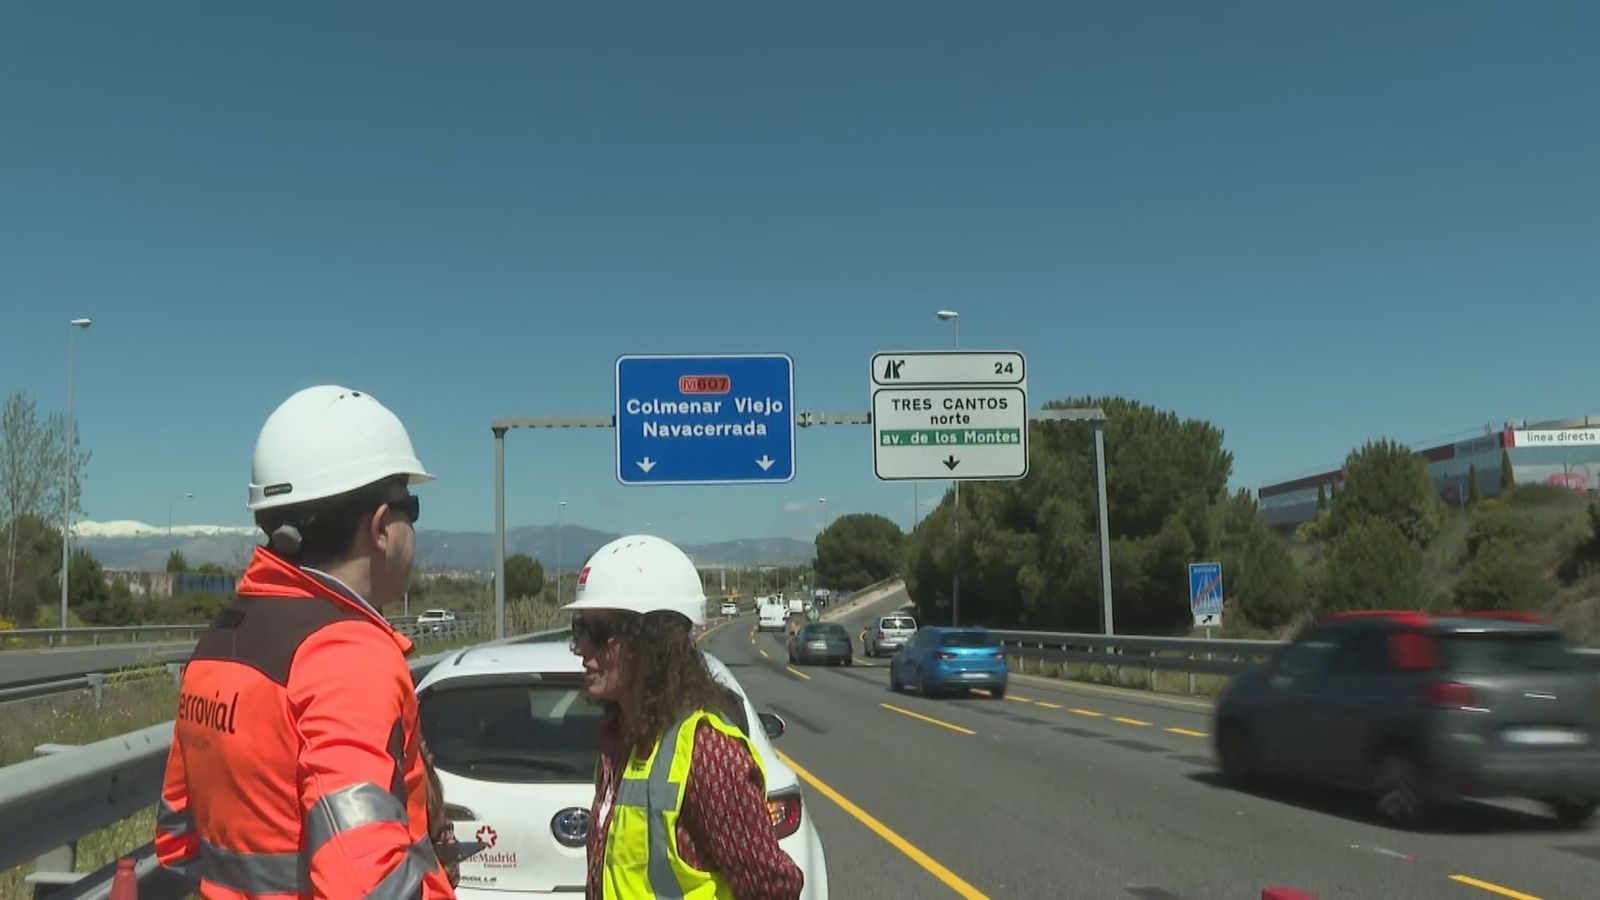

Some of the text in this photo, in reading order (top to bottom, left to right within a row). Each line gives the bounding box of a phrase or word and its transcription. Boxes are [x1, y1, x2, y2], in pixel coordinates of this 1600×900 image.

[994, 361, 1014, 375] 24
[626, 397, 783, 416] Colmenar Viejo
[891, 397, 1008, 411] TRES CANTOS
[930, 412, 970, 425] norte
[642, 420, 767, 437] Navacerrada
[882, 430, 1018, 445] av. de los Montes
[1557, 431, 1595, 441] directa
[179, 690, 239, 734] errovial
[464, 852, 517, 863] leMadrid
